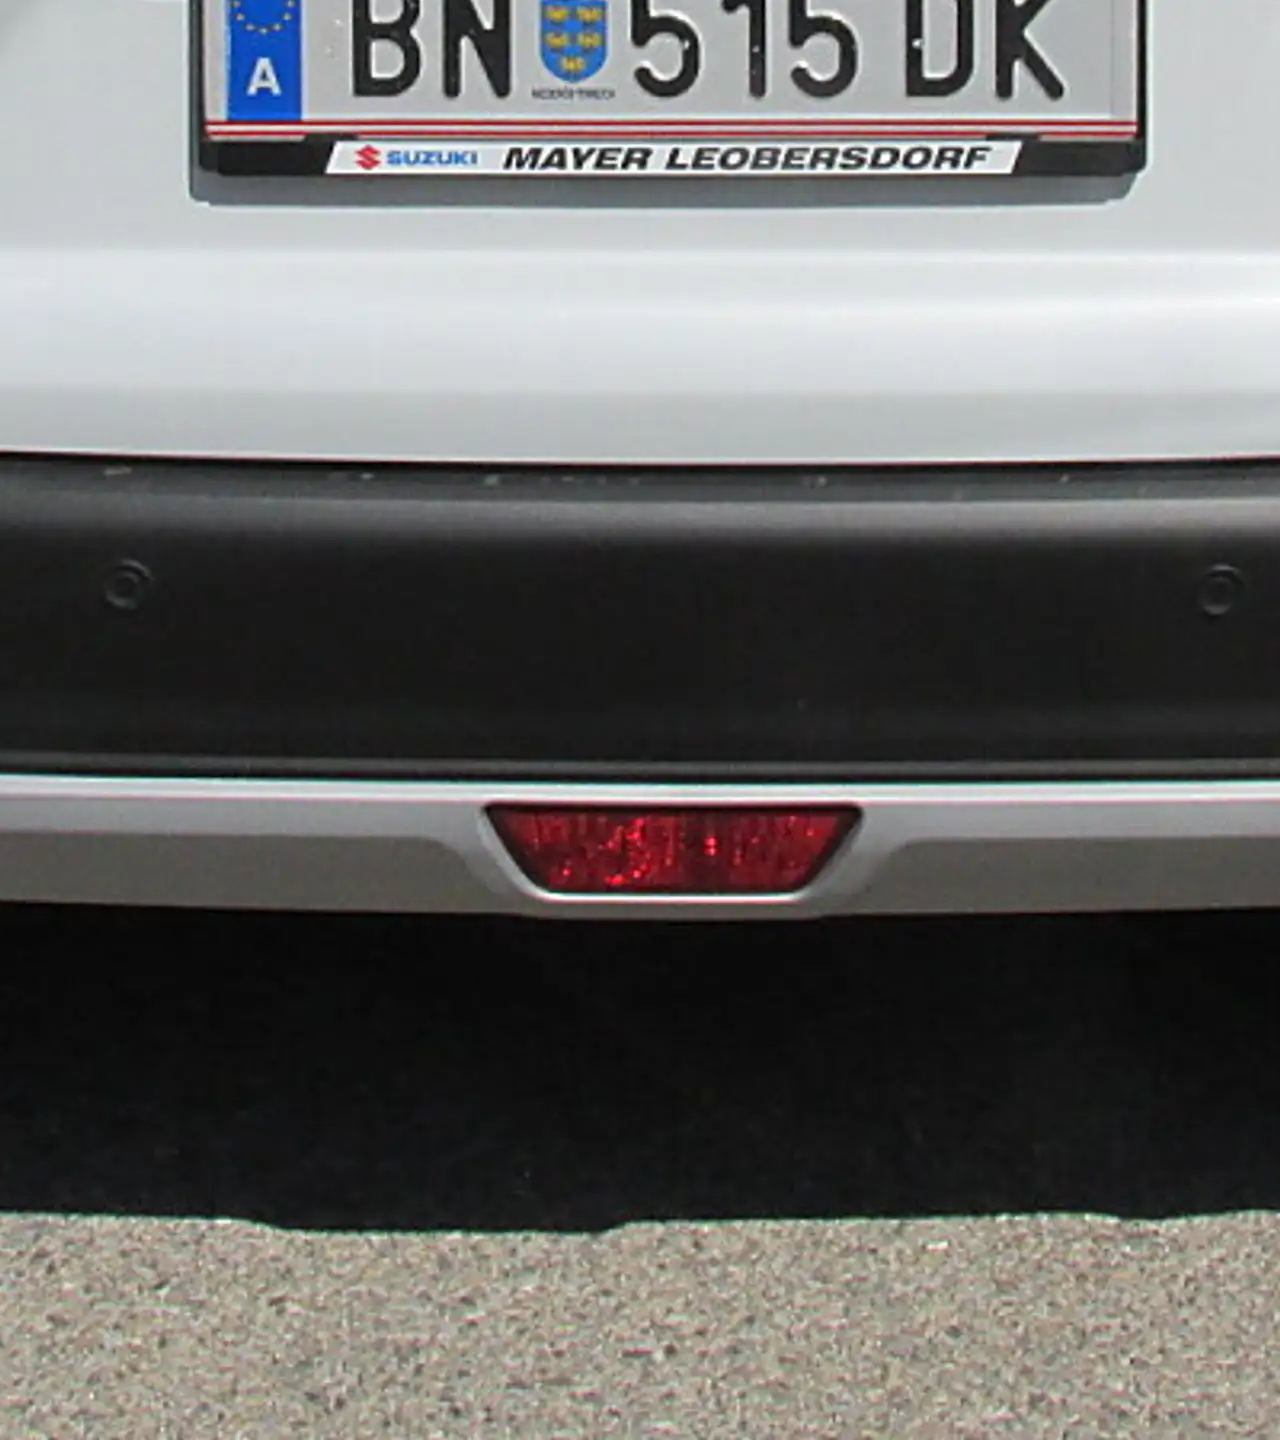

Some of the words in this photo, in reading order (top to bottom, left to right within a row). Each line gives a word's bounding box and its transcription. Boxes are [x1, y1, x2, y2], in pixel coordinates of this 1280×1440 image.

[246, 58, 280, 95] A
[386, 150, 478, 166] SUZUKI
[502, 147, 653, 170] MAYER
[665, 146, 993, 171] LEOBERSDORF
